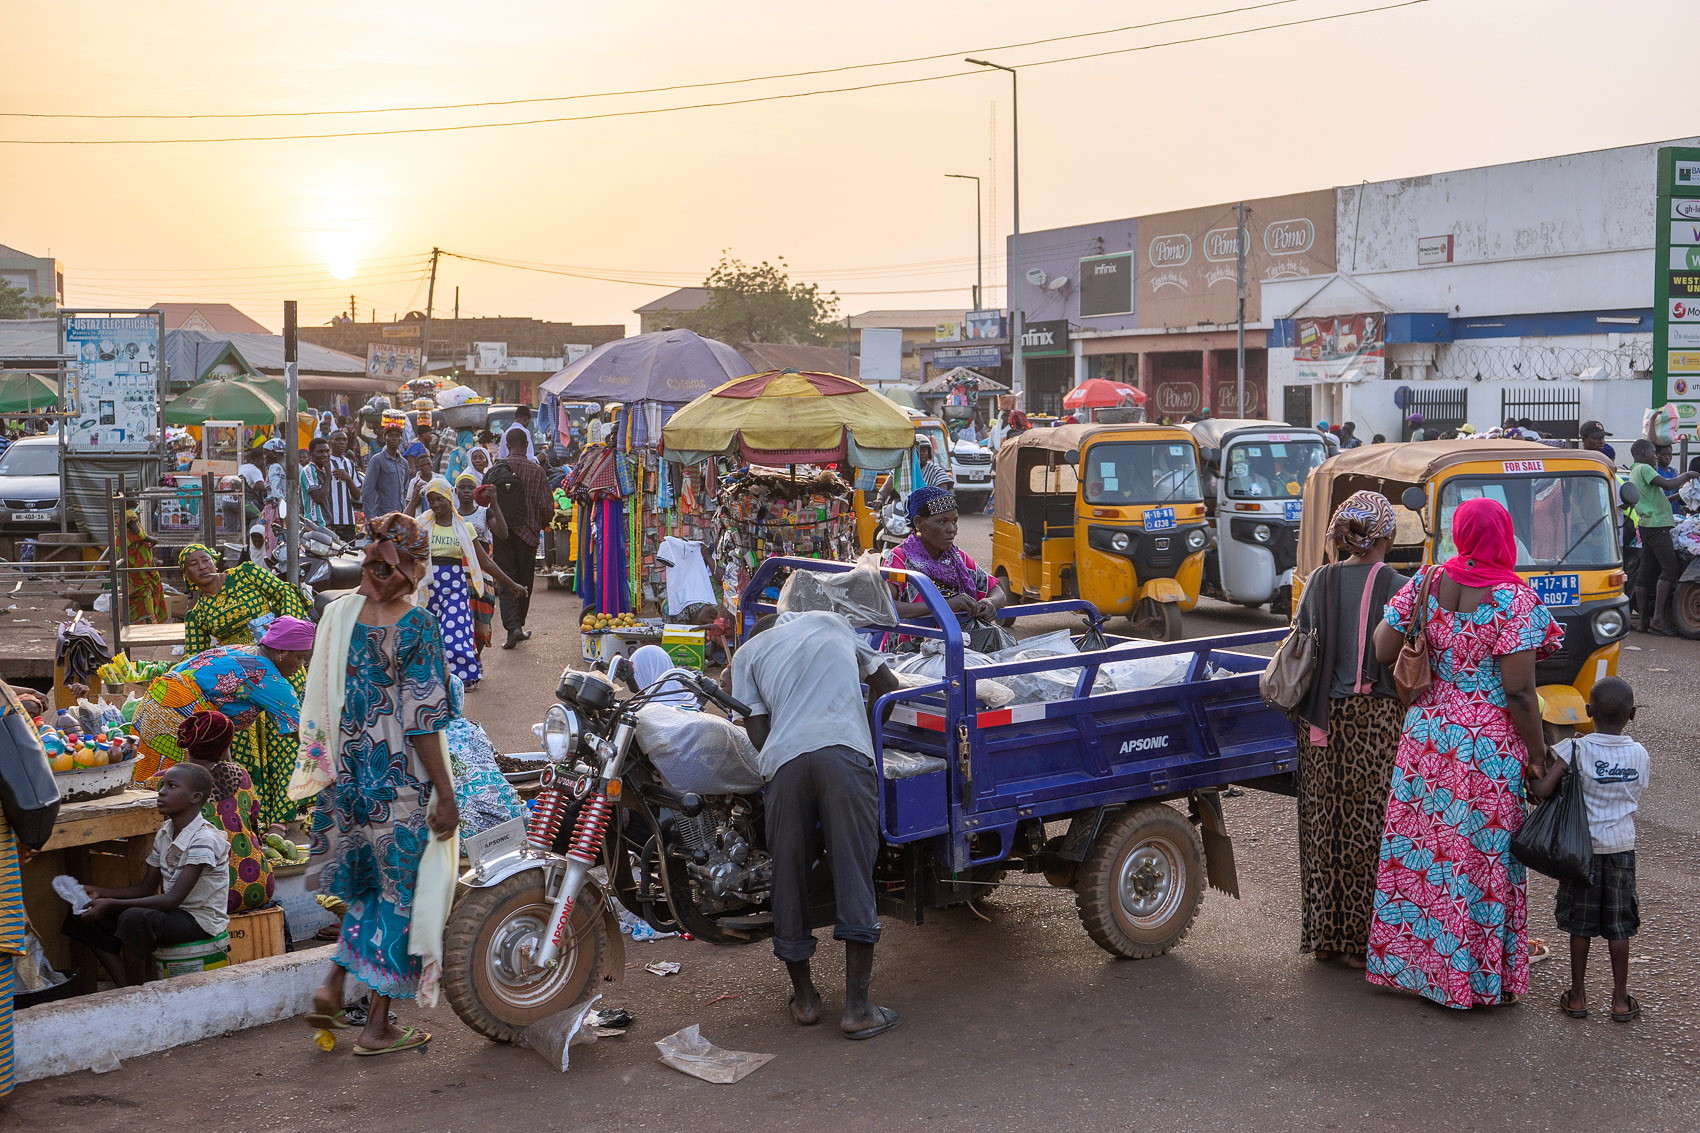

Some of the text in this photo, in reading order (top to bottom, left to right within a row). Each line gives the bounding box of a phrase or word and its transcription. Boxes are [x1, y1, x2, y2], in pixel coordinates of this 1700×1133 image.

[1673, 276, 1700, 284] WEST
[68, 320, 154, 330] F-USTAZ ELECTRICALS
[1021, 328, 1054, 347] nfinix
[1504, 462, 1542, 472] FOR SALE
[432, 536, 460, 547] INKING
[1544, 592, 1568, 604] 6097
[1119, 734, 1169, 754] APSONIC
[484, 834, 511, 849] APSONIC
[552, 896, 576, 948] APSONIC
